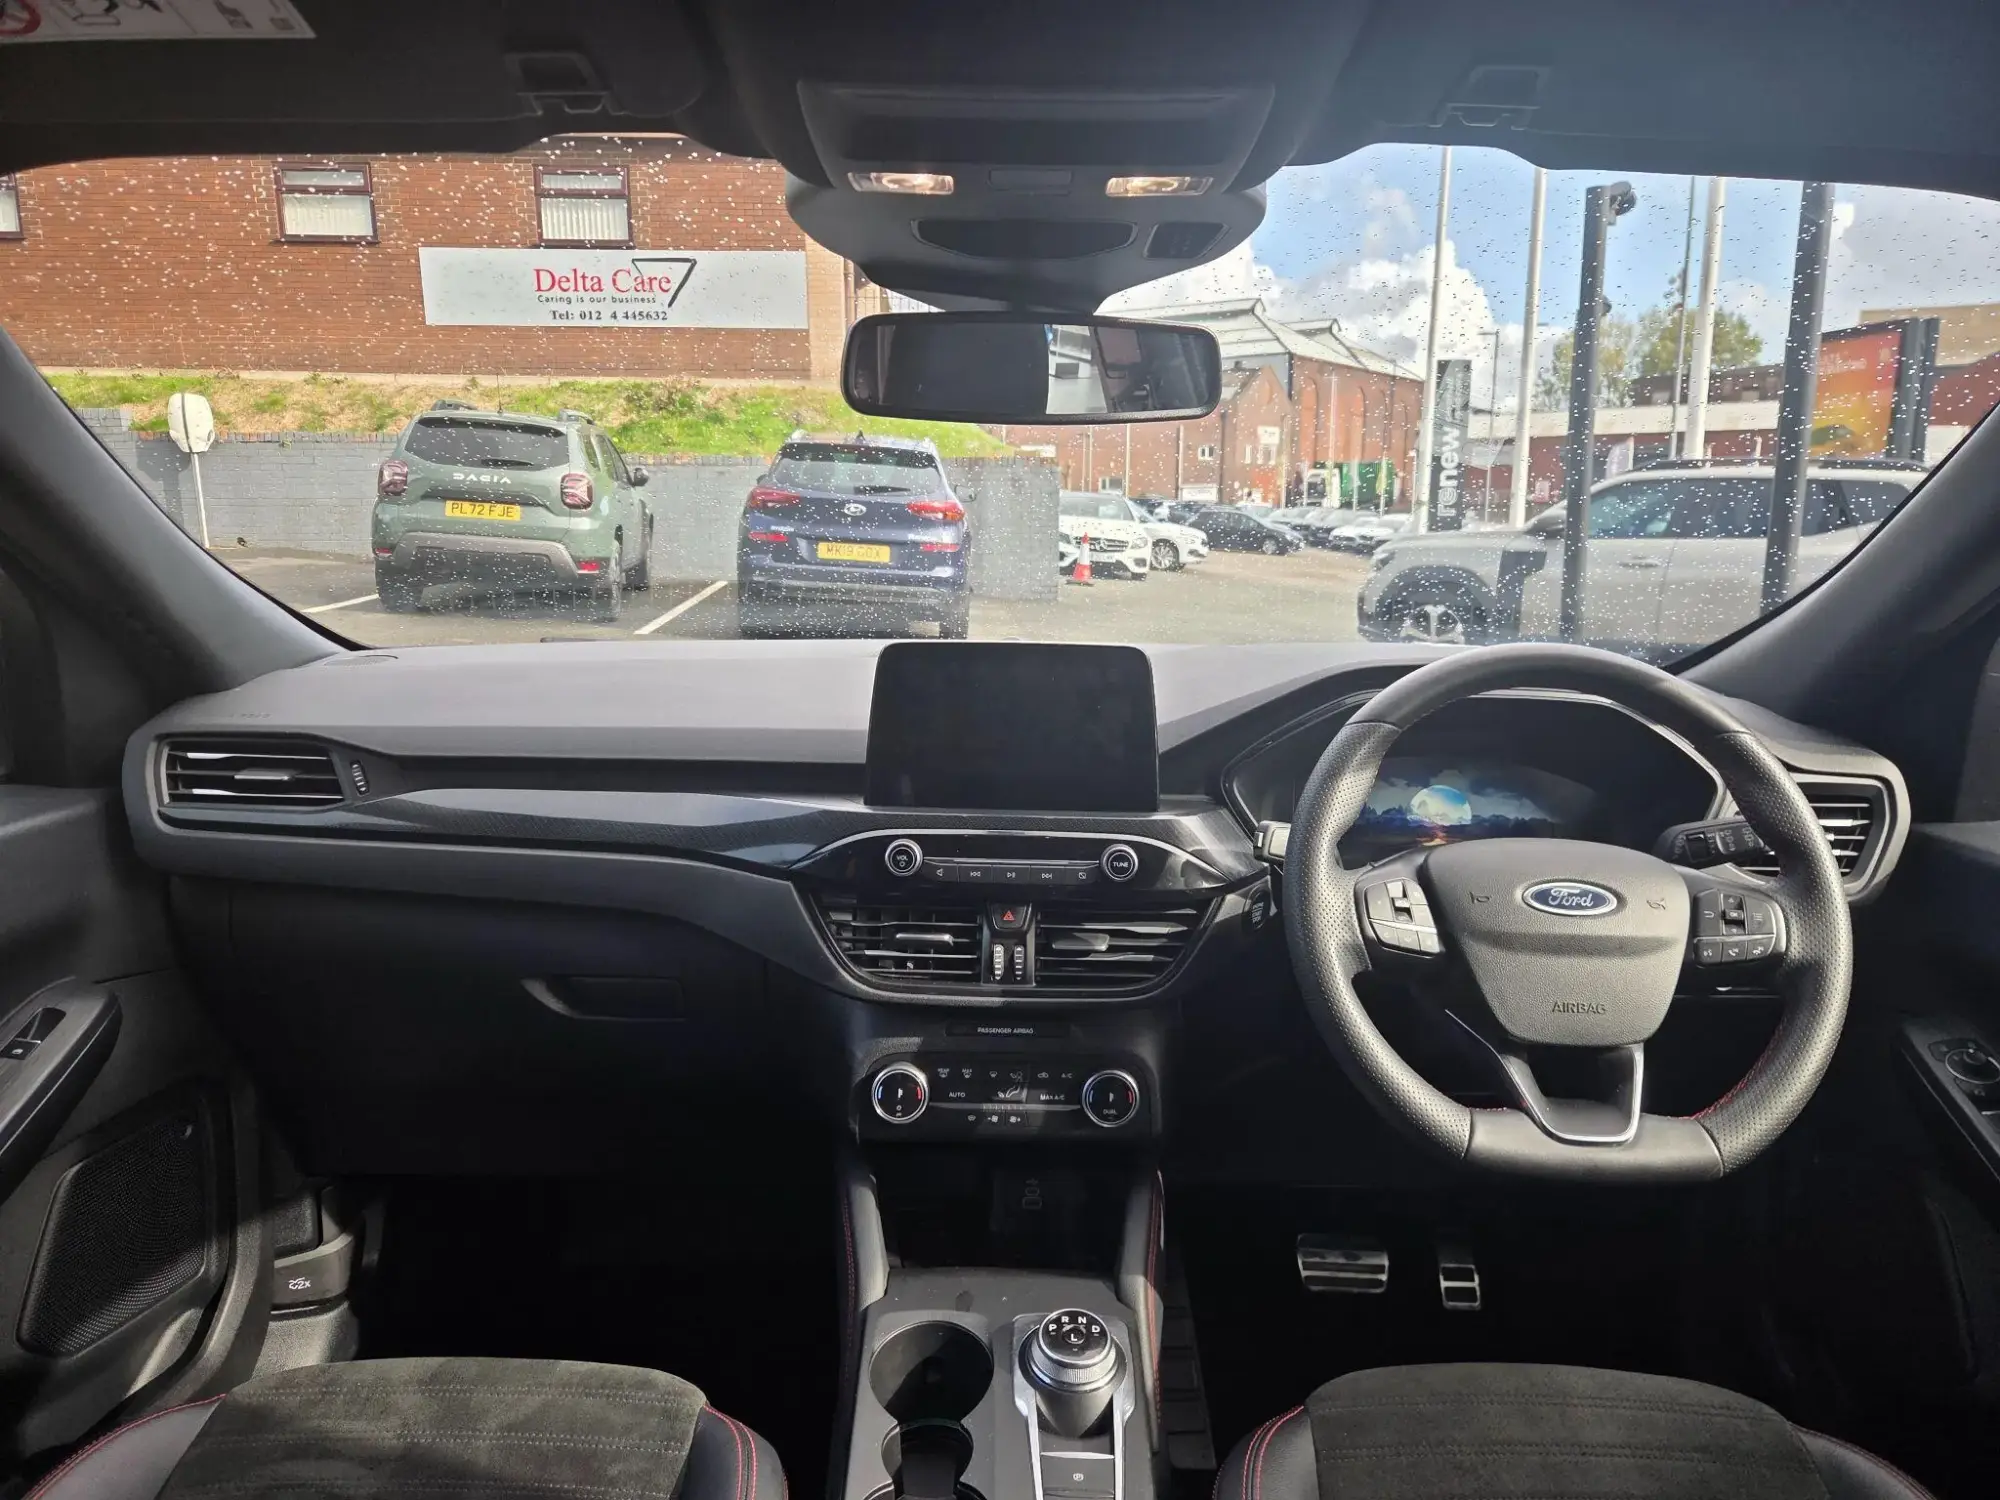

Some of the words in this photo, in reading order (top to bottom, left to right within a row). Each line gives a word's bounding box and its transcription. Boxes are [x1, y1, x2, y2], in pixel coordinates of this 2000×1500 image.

[533, 268, 604, 293] Delta
[611, 268, 672, 293] Care
[537, 295, 572, 305] Caring
[576, 295, 584, 303] is
[611, 295, 656, 304] business
[551, 310, 574, 320] Tel:
[1436, 427, 1461, 517] renew
[452, 472, 512, 484] DACIA
[451, 502, 485, 516] PL72
[488, 505, 514, 518] FJE
[1548, 888, 1594, 907] Ford
[1551, 1001, 1607, 1014] AIRBAG
[1077, 1316, 1087, 1324] N
[1048, 1323, 1058, 1332] P
[1091, 1325, 1101, 1333] D
[1070, 1333, 1078, 1342] L
